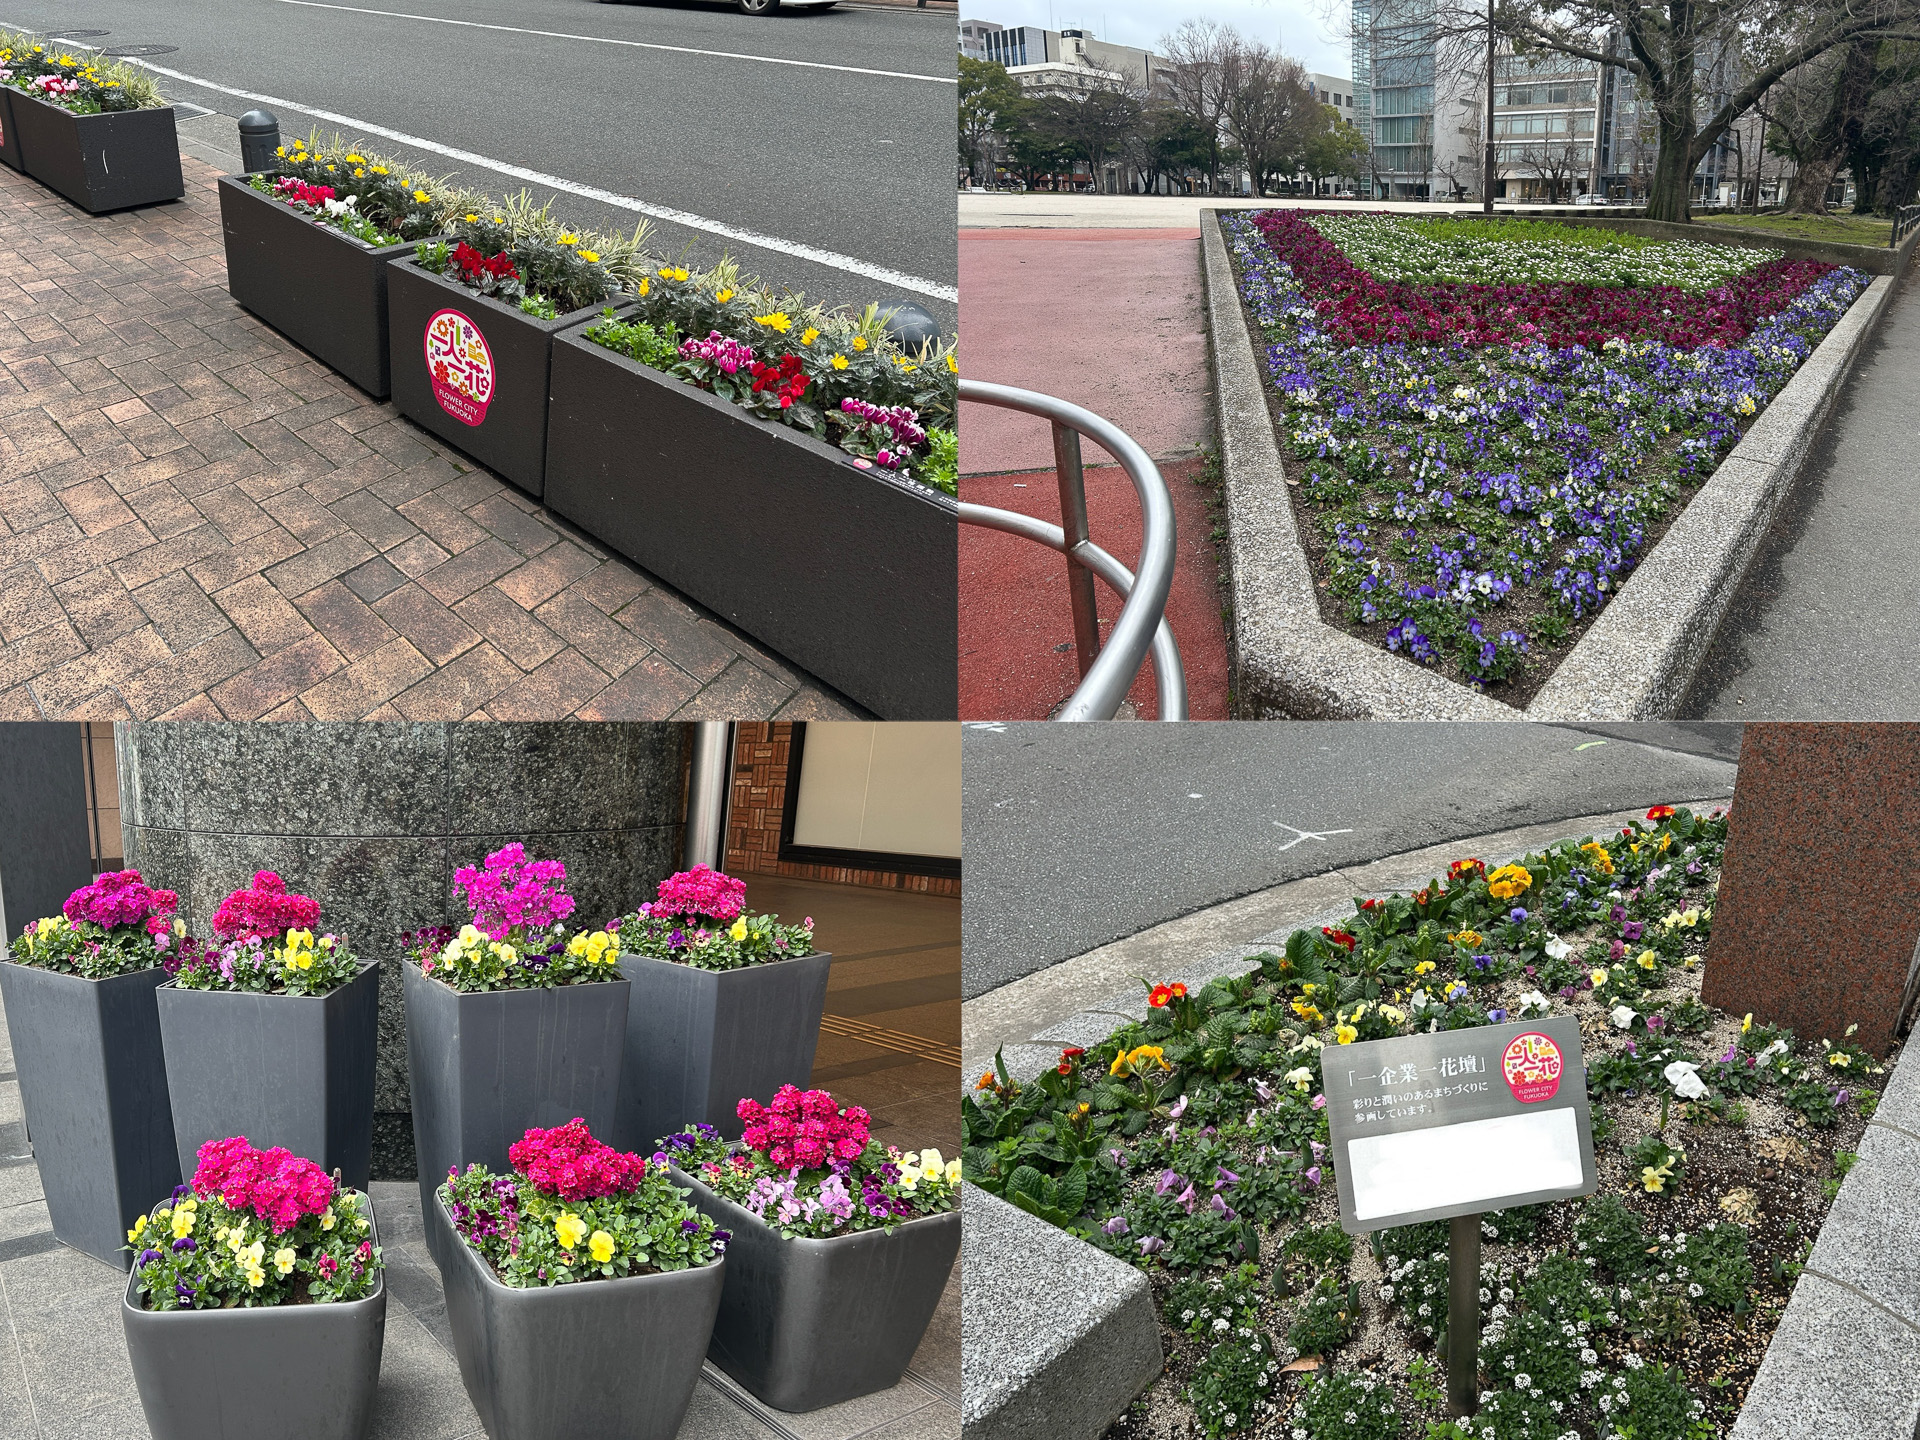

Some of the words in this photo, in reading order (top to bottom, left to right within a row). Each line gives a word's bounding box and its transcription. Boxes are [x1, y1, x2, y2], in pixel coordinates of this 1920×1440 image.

[439, 389, 463, 408] FLOWER
[463, 403, 478, 415] CITY
[443, 400, 473, 422] FUKUOKA
[1348, 1055, 1487, 1087] 「一企業一花壇」
[1352, 1082, 1489, 1110] 彩りと潤いのあるまちづくりに
[1518, 1087, 1540, 1095] FLOWER
[1523, 1091, 1549, 1100] FUKUOKA
[1354, 1104, 1433, 1124] 参画しています。
